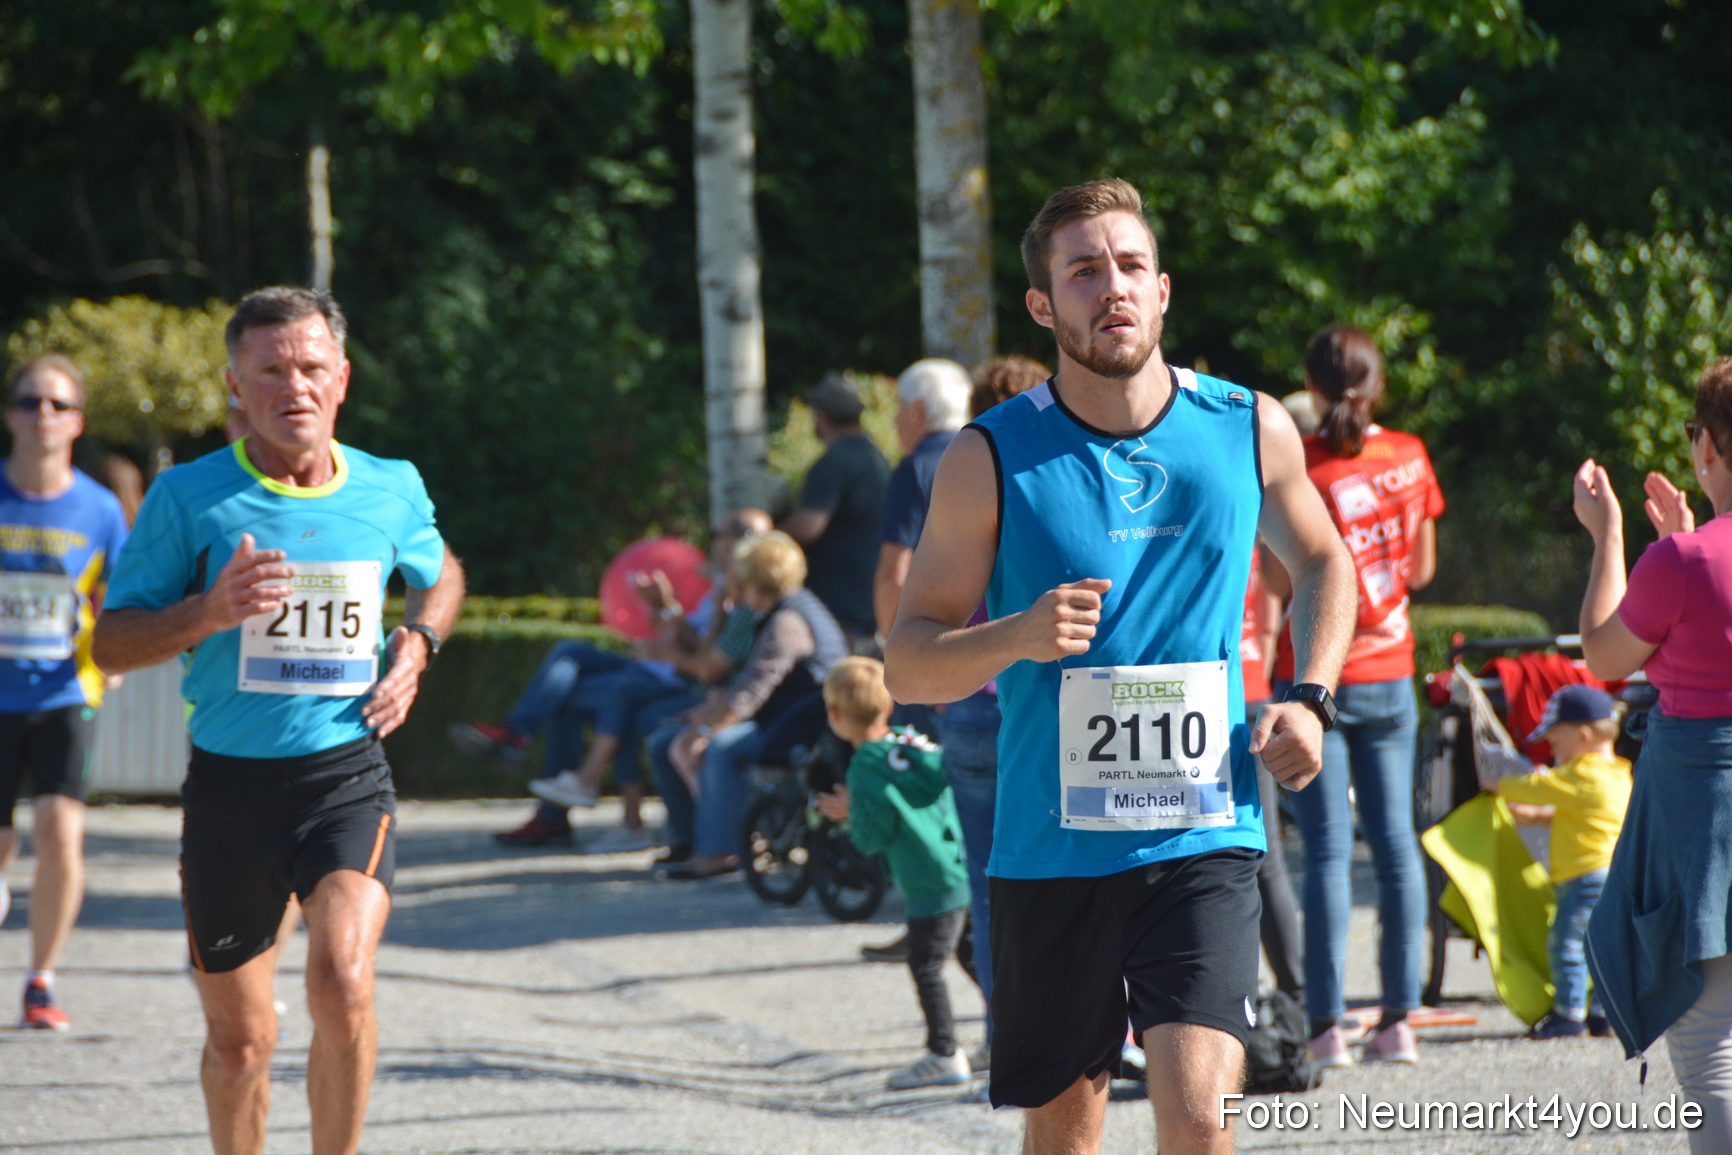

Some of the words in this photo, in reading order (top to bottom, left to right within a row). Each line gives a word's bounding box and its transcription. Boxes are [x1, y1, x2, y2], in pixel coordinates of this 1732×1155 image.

[1108, 529, 1129, 543] TV
[1130, 524, 1184, 540] Velburg
[265, 599, 361, 639] 2115
[280, 662, 345, 680] Michael
[1111, 681, 1185, 700] BOCK
[1087, 711, 1207, 762] 2110
[1070, 751, 1077, 762] D
[1098, 771, 1134, 780] PARTL
[1137, 768, 1187, 779] Neumarkt
[1114, 791, 1185, 809] Michael
